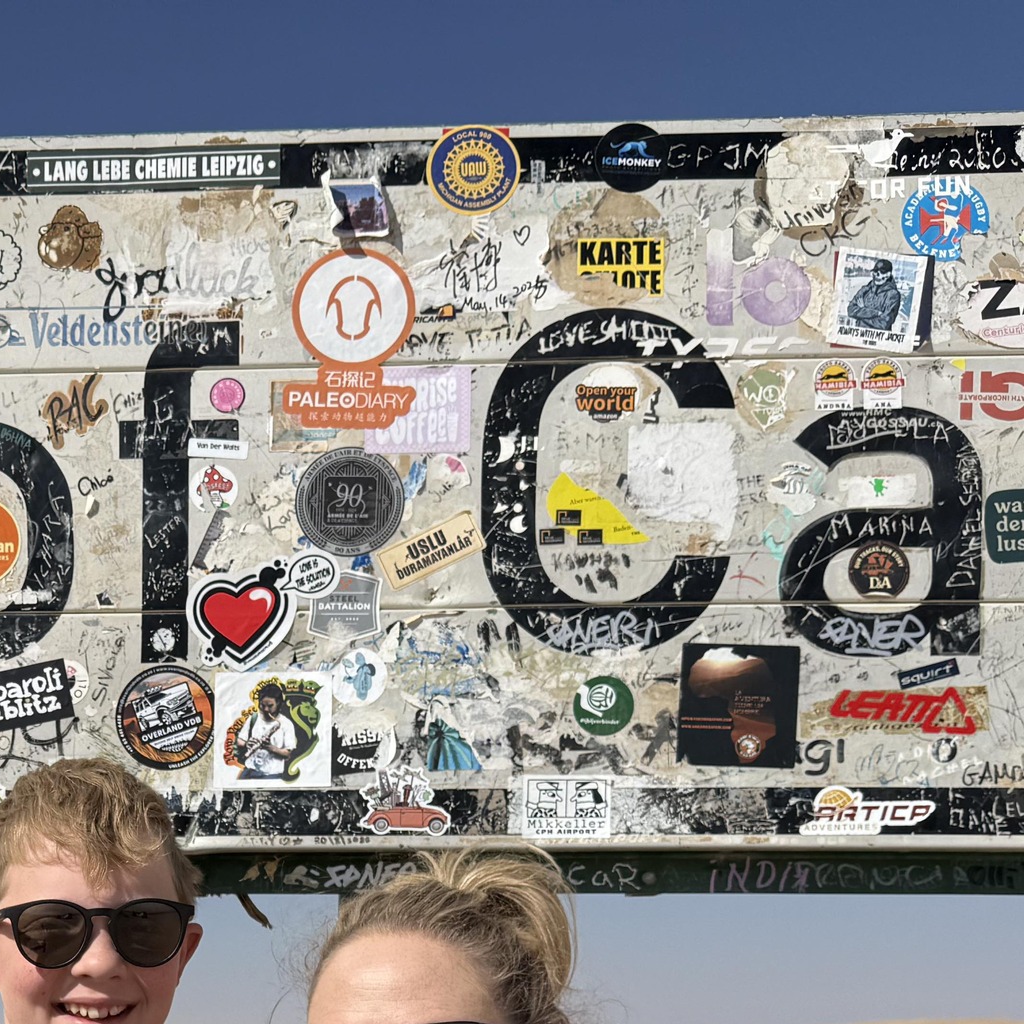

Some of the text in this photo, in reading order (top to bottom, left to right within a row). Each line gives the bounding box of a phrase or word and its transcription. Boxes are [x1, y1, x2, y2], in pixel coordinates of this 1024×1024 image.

[452, 131, 477, 143] LOCAL
[43, 154, 264, 182] LANG LEBE CHEMIE LEIPZIG
[460, 161, 487, 177] UAW
[602, 156, 662, 167] ICEMONKEY
[438, 176, 511, 209] MICHIGAN ASSEMBLY PLANT
[968, 189, 986, 223] RUGBY
[580, 241, 663, 265] KARTE
[874, 331, 885, 340] MY
[325, 371, 376, 388] 石探记
[288, 391, 410, 409] PALEODIARY
[576, 385, 636, 400] Open your
[576, 394, 635, 412] world
[592, 413, 618, 421] amazon
[336, 483, 363, 508] 90
[406, 529, 448, 560] USLU
[299, 561, 313, 574] LOVE
[296, 567, 331, 588] THE SOLUTION
[318, 602, 371, 611] BATTALION
[330, 595, 359, 603] STEEL
[901, 664, 955, 686] squirt
[141, 715, 203, 742] OVERLAND VDB
[528, 819, 606, 830] Mikkeller
[804, 823, 879, 831] ADVENTURES
